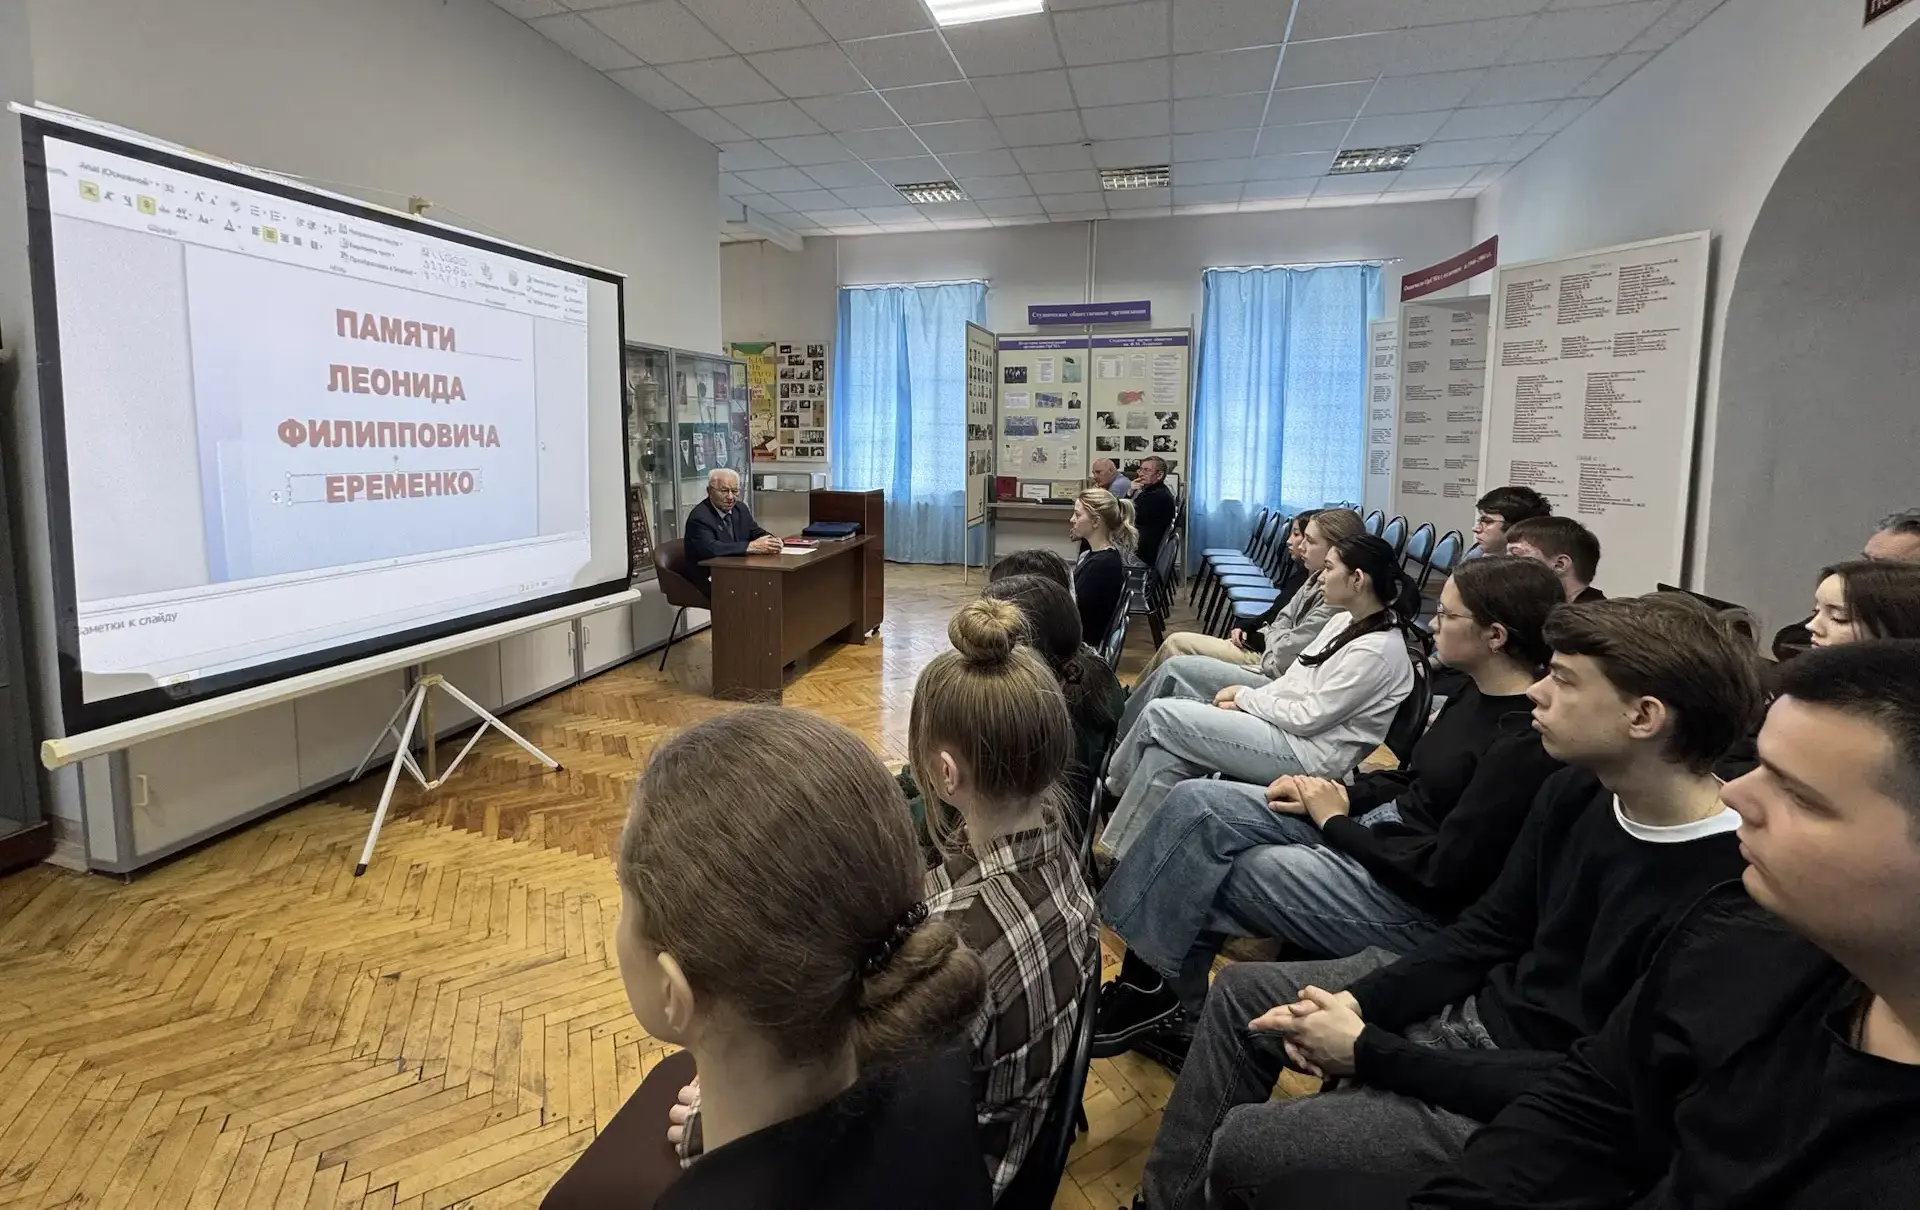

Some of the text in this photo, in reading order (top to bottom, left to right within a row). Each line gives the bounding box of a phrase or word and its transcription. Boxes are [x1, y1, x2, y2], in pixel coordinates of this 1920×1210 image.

[336, 308, 456, 352] ПАМЯТИ
[327, 364, 466, 404] ЛЕОНИДА
[278, 418, 500, 448] ФИЛИППОВИЧА
[325, 470, 474, 503] ЕРЕМЕНКО
[80, 612, 178, 636] аметки к слайду
